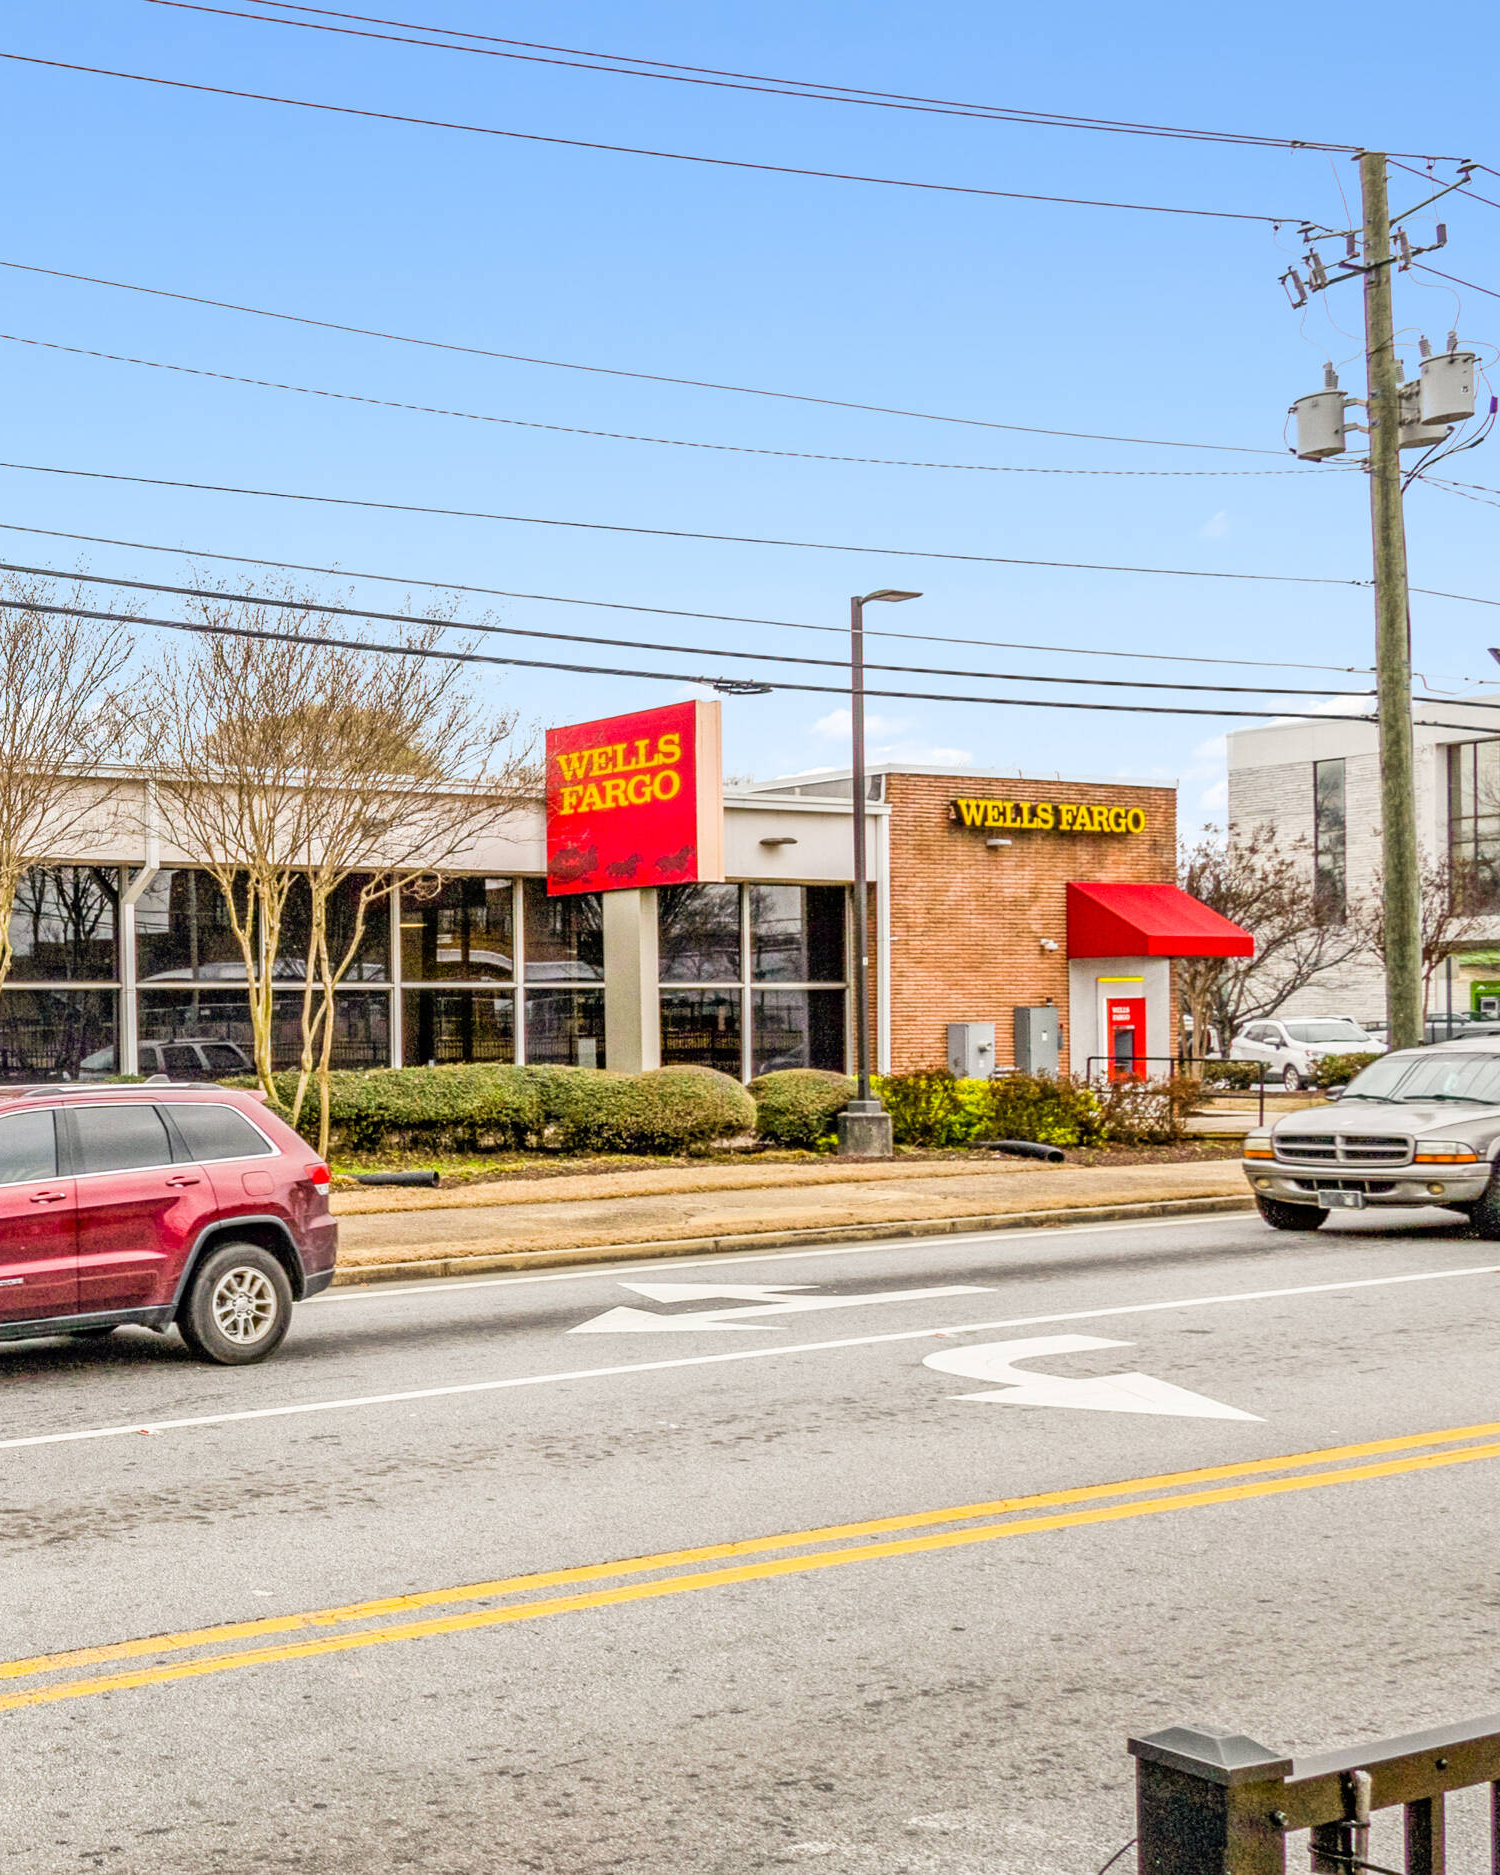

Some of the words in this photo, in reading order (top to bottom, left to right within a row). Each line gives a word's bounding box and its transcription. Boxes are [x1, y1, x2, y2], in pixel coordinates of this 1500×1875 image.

[556, 732, 682, 782] WELLS
[559, 769, 681, 815] FARGO
[957, 798, 1054, 830] WELLS
[1058, 803, 1146, 834] FARGO
